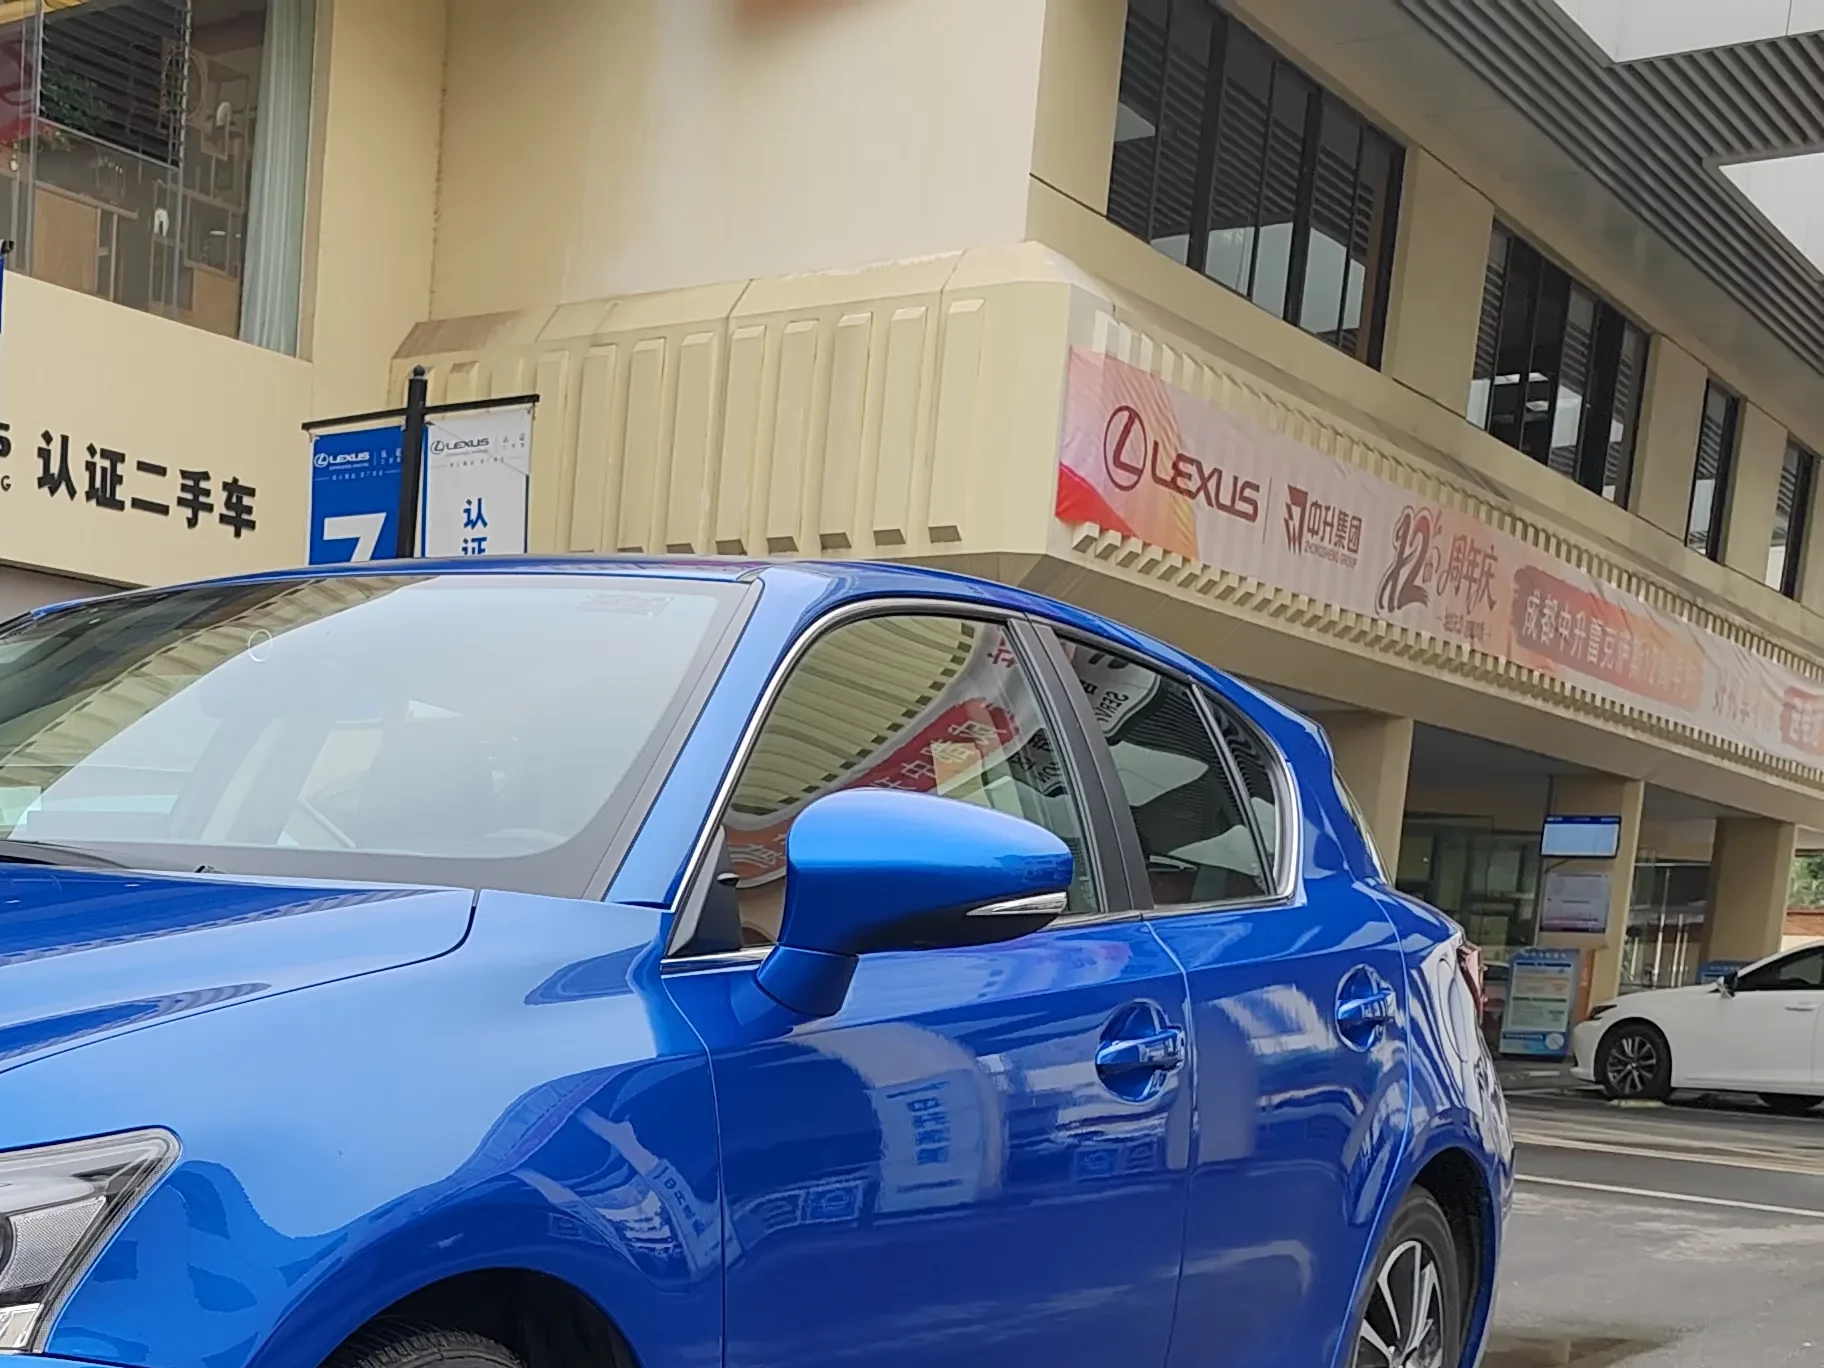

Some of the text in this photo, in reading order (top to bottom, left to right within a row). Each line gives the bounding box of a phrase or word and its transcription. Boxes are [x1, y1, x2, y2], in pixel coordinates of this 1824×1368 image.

[329, 451, 370, 463] LEXUS
[446, 438, 490, 450] LEXUS
[37, 429, 257, 539] 认证二手车
[1150, 440, 1260, 523] LEXUS
[1307, 499, 1363, 554] 中升集团
